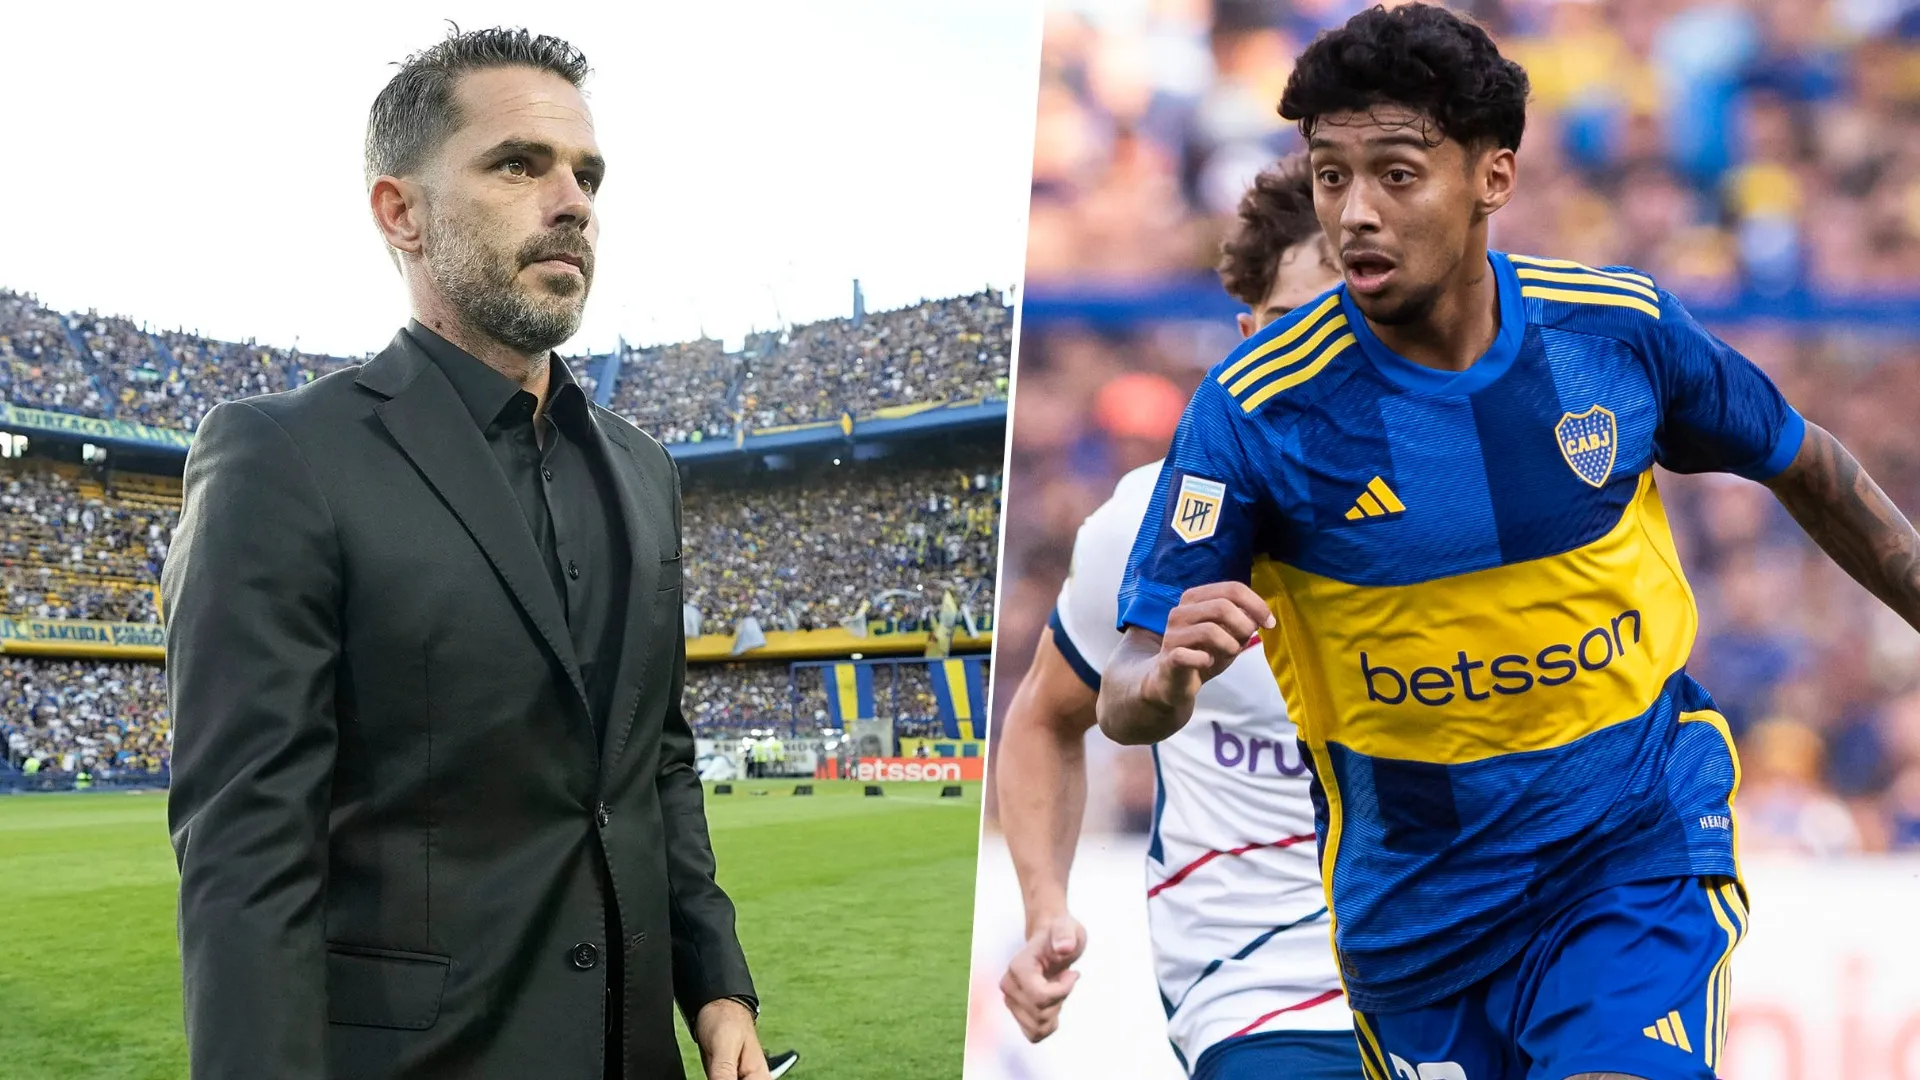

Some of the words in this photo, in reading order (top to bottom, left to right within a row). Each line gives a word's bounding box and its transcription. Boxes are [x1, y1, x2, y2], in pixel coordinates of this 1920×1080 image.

[1566, 431, 1610, 455] CABJ
[1360, 609, 1641, 706] betsson
[847, 759, 961, 782] etsson
